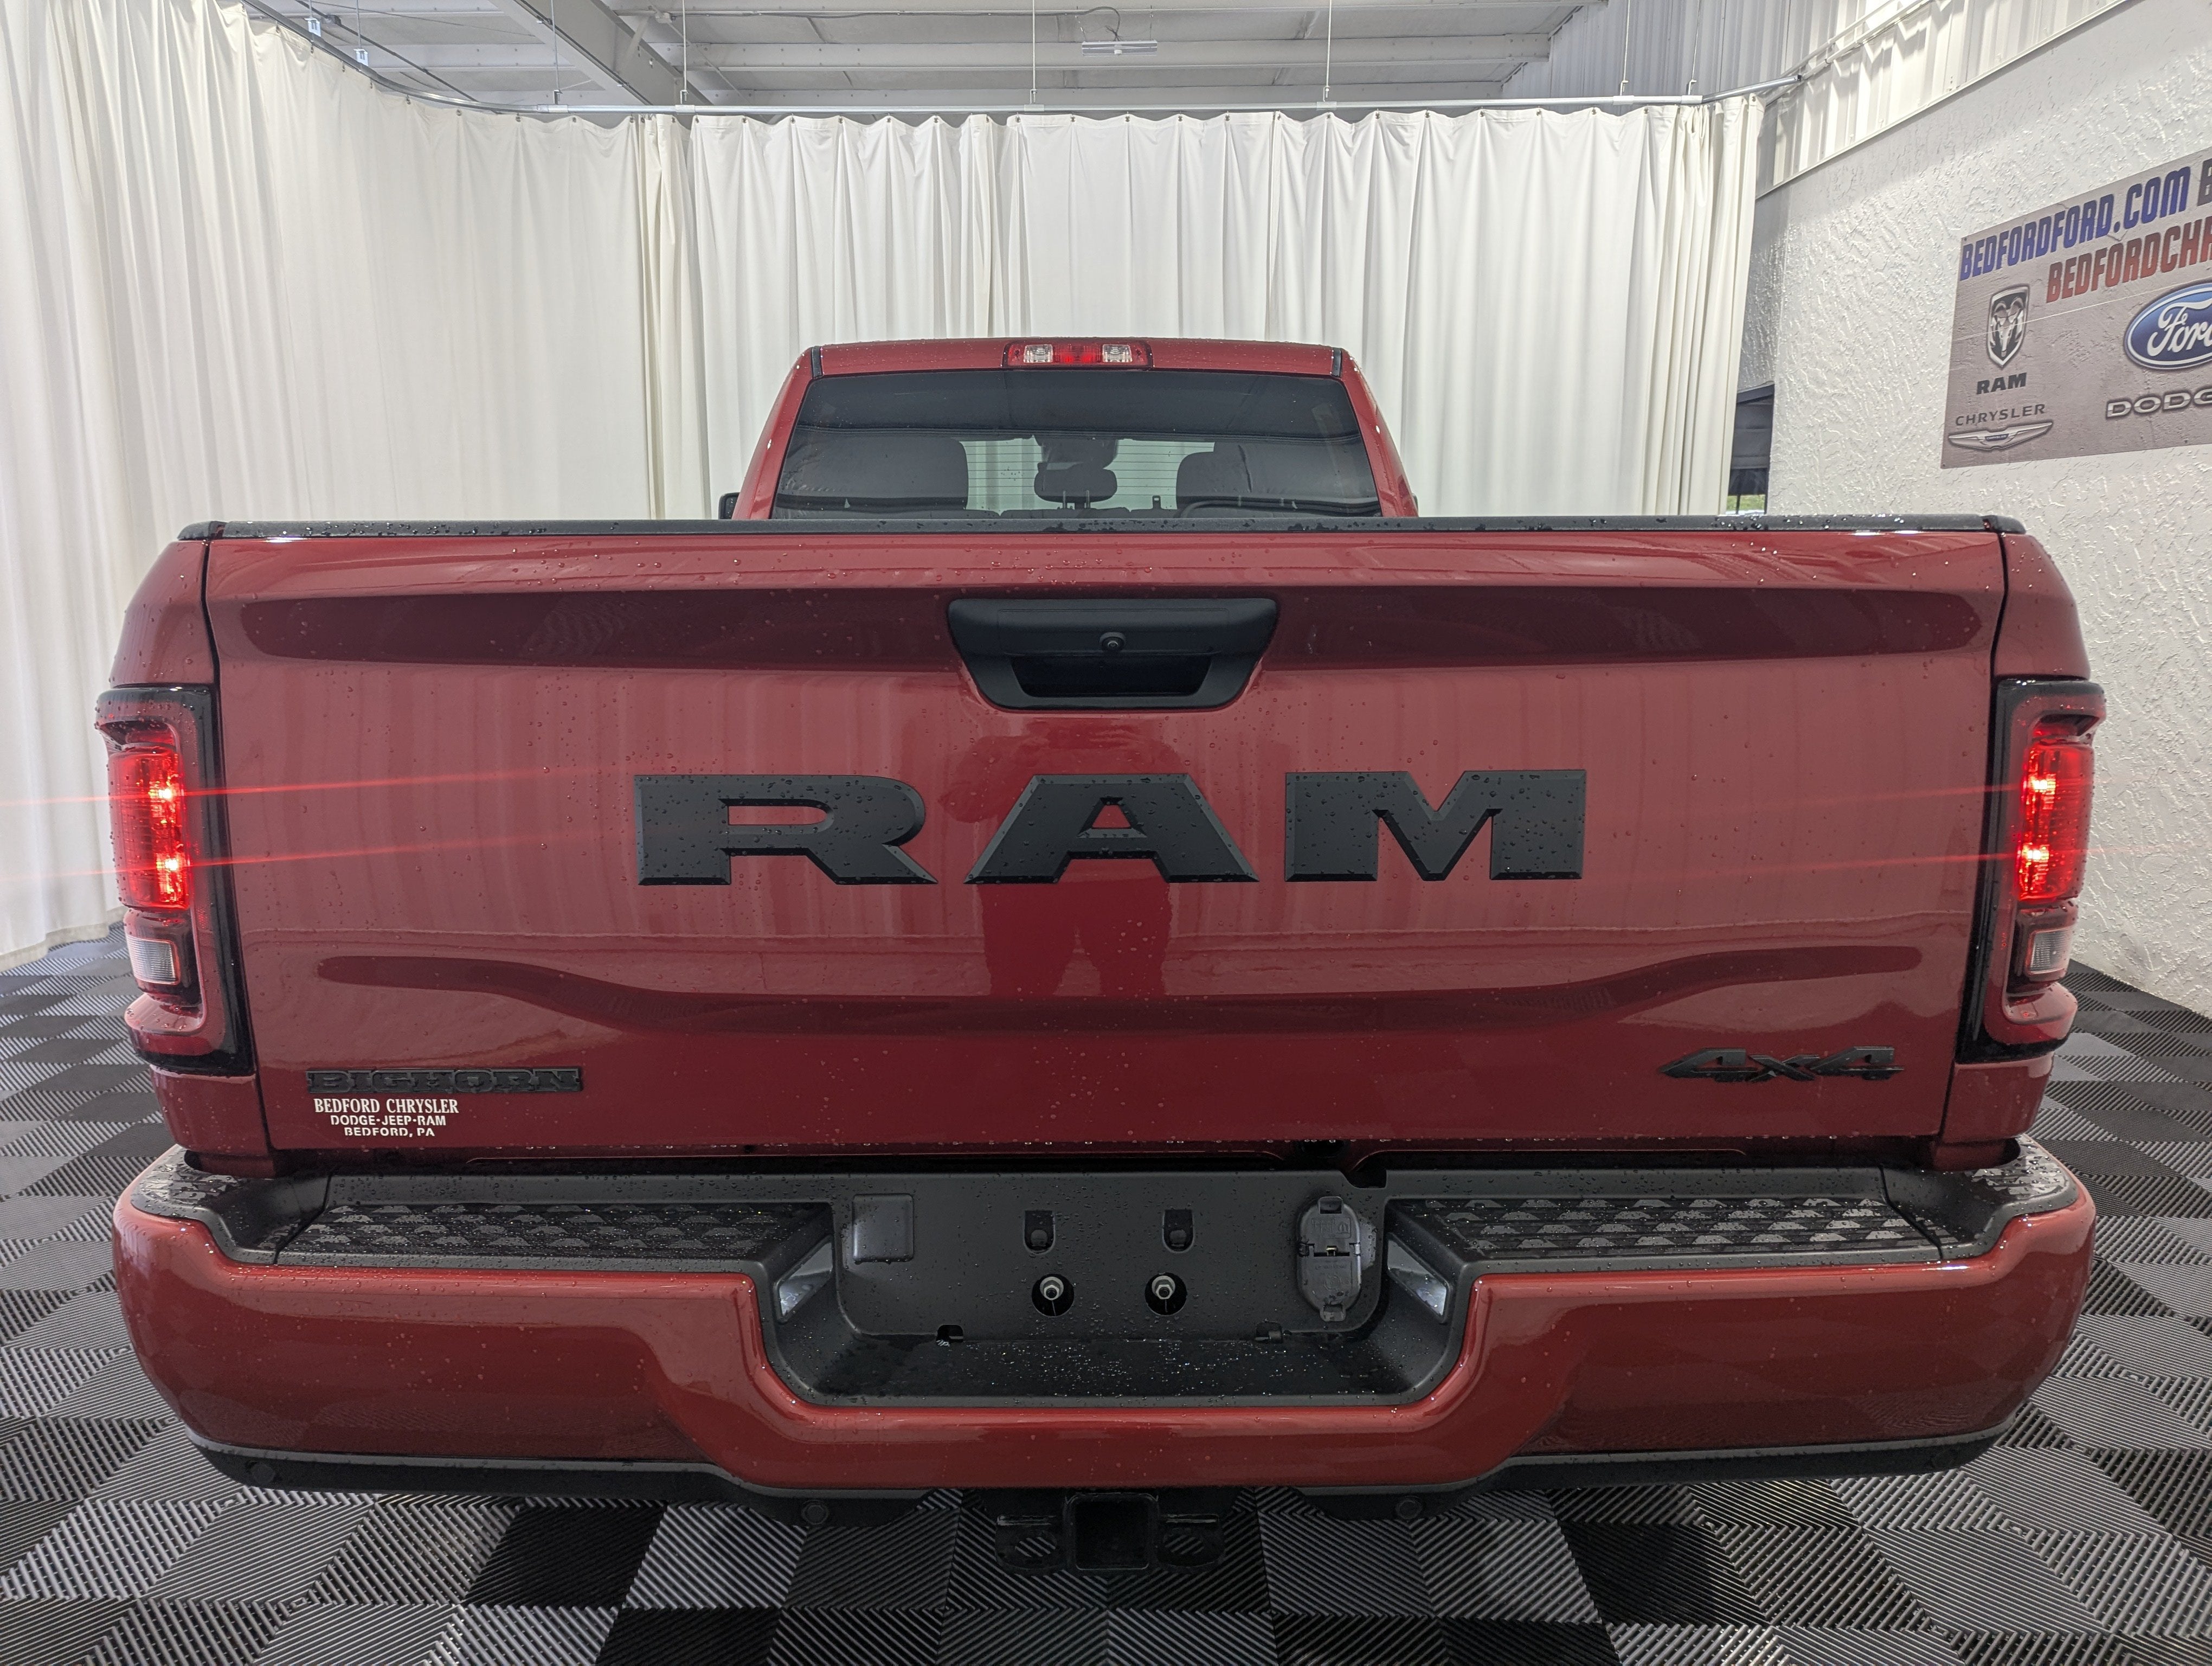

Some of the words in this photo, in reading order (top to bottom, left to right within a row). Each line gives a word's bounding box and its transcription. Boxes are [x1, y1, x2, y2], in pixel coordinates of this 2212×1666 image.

[1959, 165, 2191, 281] BEDFORDFORD.COM
[1976, 372, 2027, 395] RAM
[1955, 403, 2047, 426] CHRYSLER
[633, 768, 1587, 886] RAM
[313, 1098, 380, 1113] BEDFORD
[386, 1098, 460, 1114] CHRYSLER
[344, 1127, 413, 1138] BEDFORD,
[417, 1127, 435, 1137] PA
